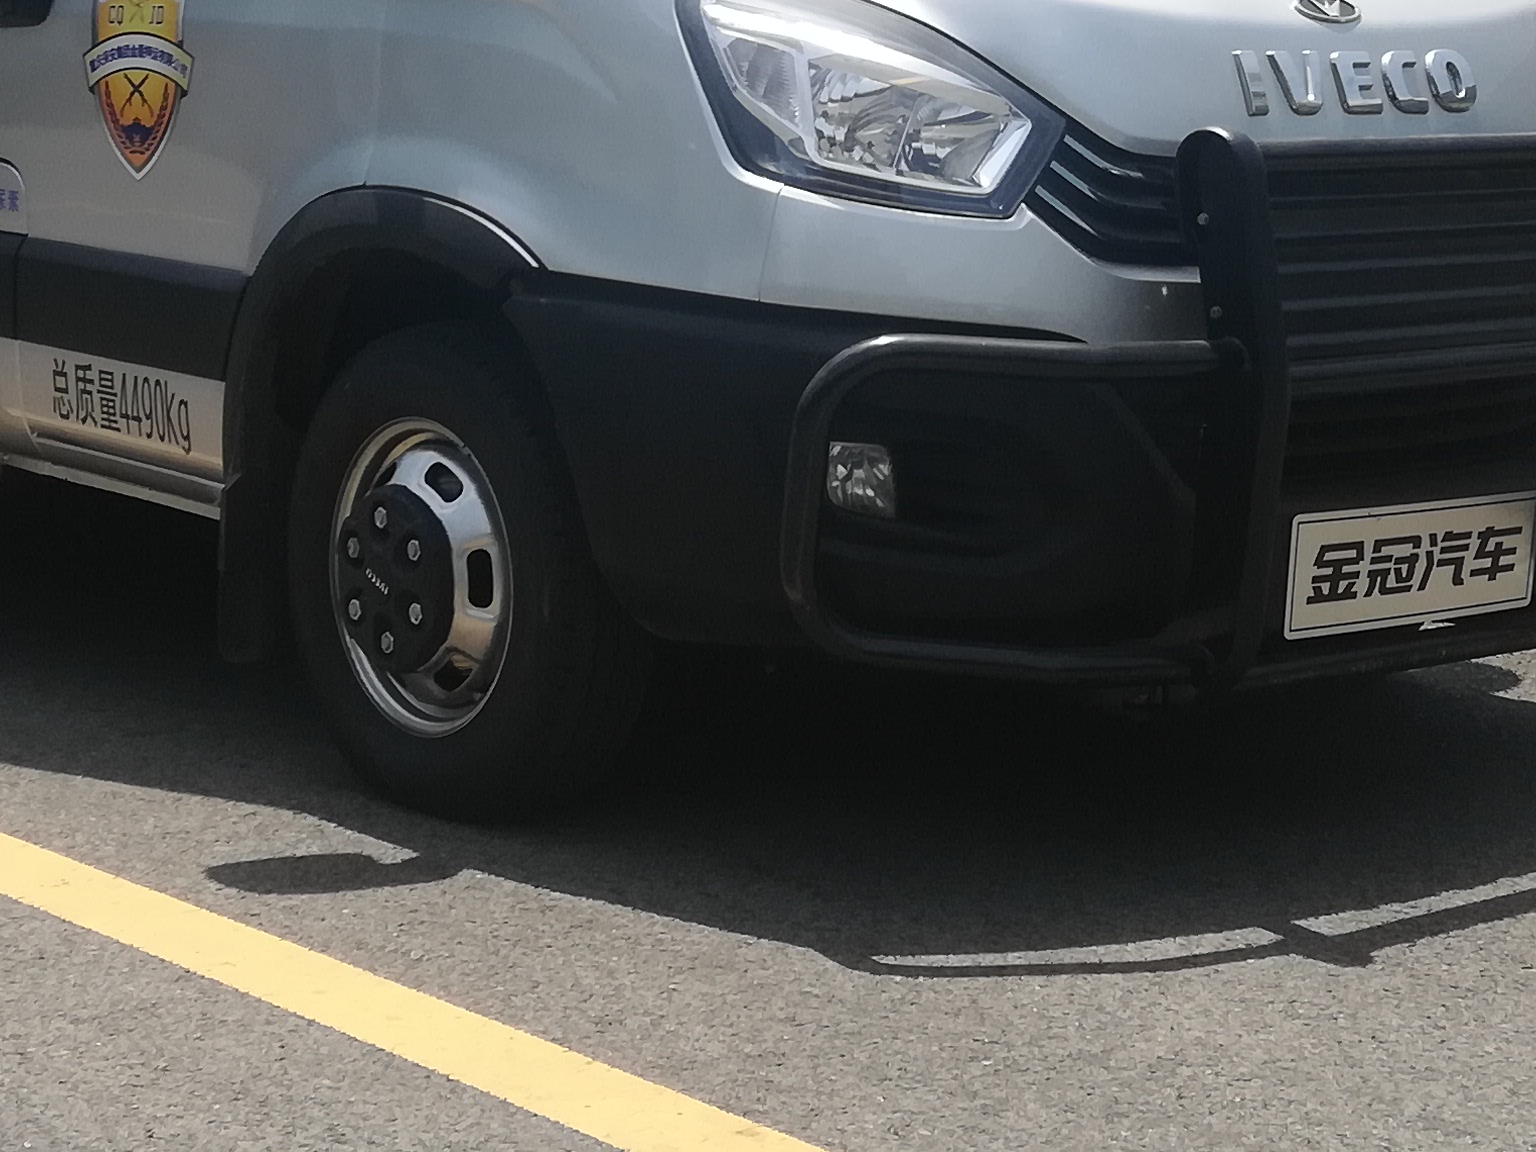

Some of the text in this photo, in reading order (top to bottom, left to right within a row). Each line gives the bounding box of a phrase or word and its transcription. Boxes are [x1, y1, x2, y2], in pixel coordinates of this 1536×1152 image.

[1231, 48, 1478, 118] IVECO
[52, 357, 192, 456] 总质量4490kg
[1305, 525, 1524, 606] 金冠汽车
